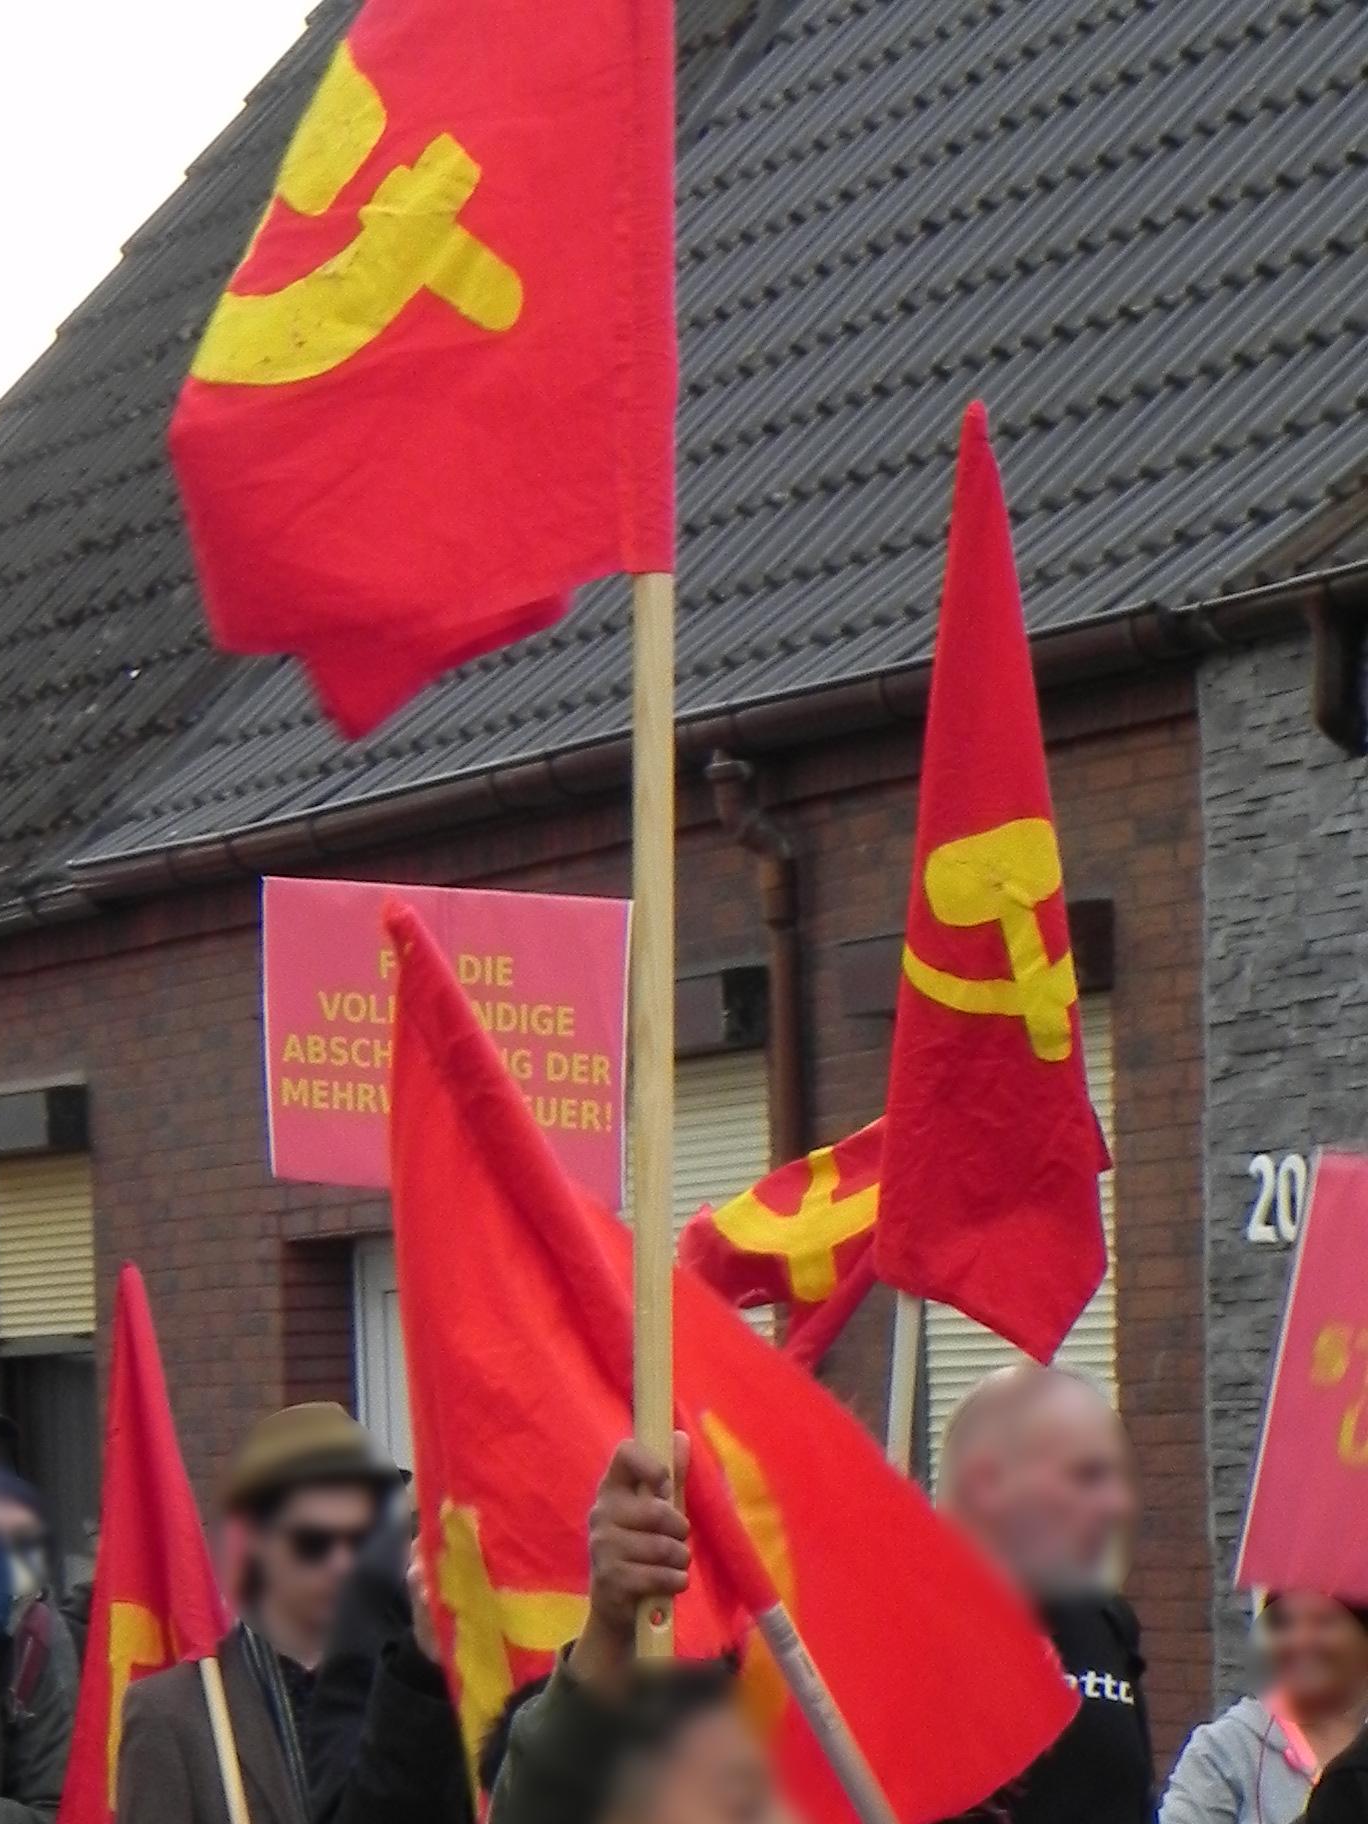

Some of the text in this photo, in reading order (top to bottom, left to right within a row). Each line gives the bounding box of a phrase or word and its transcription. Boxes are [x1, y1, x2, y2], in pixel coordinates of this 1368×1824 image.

[458, 954, 514, 987] DIE
[545, 1050, 612, 1087] DER
[1247, 1152, 1307, 1244] 20
